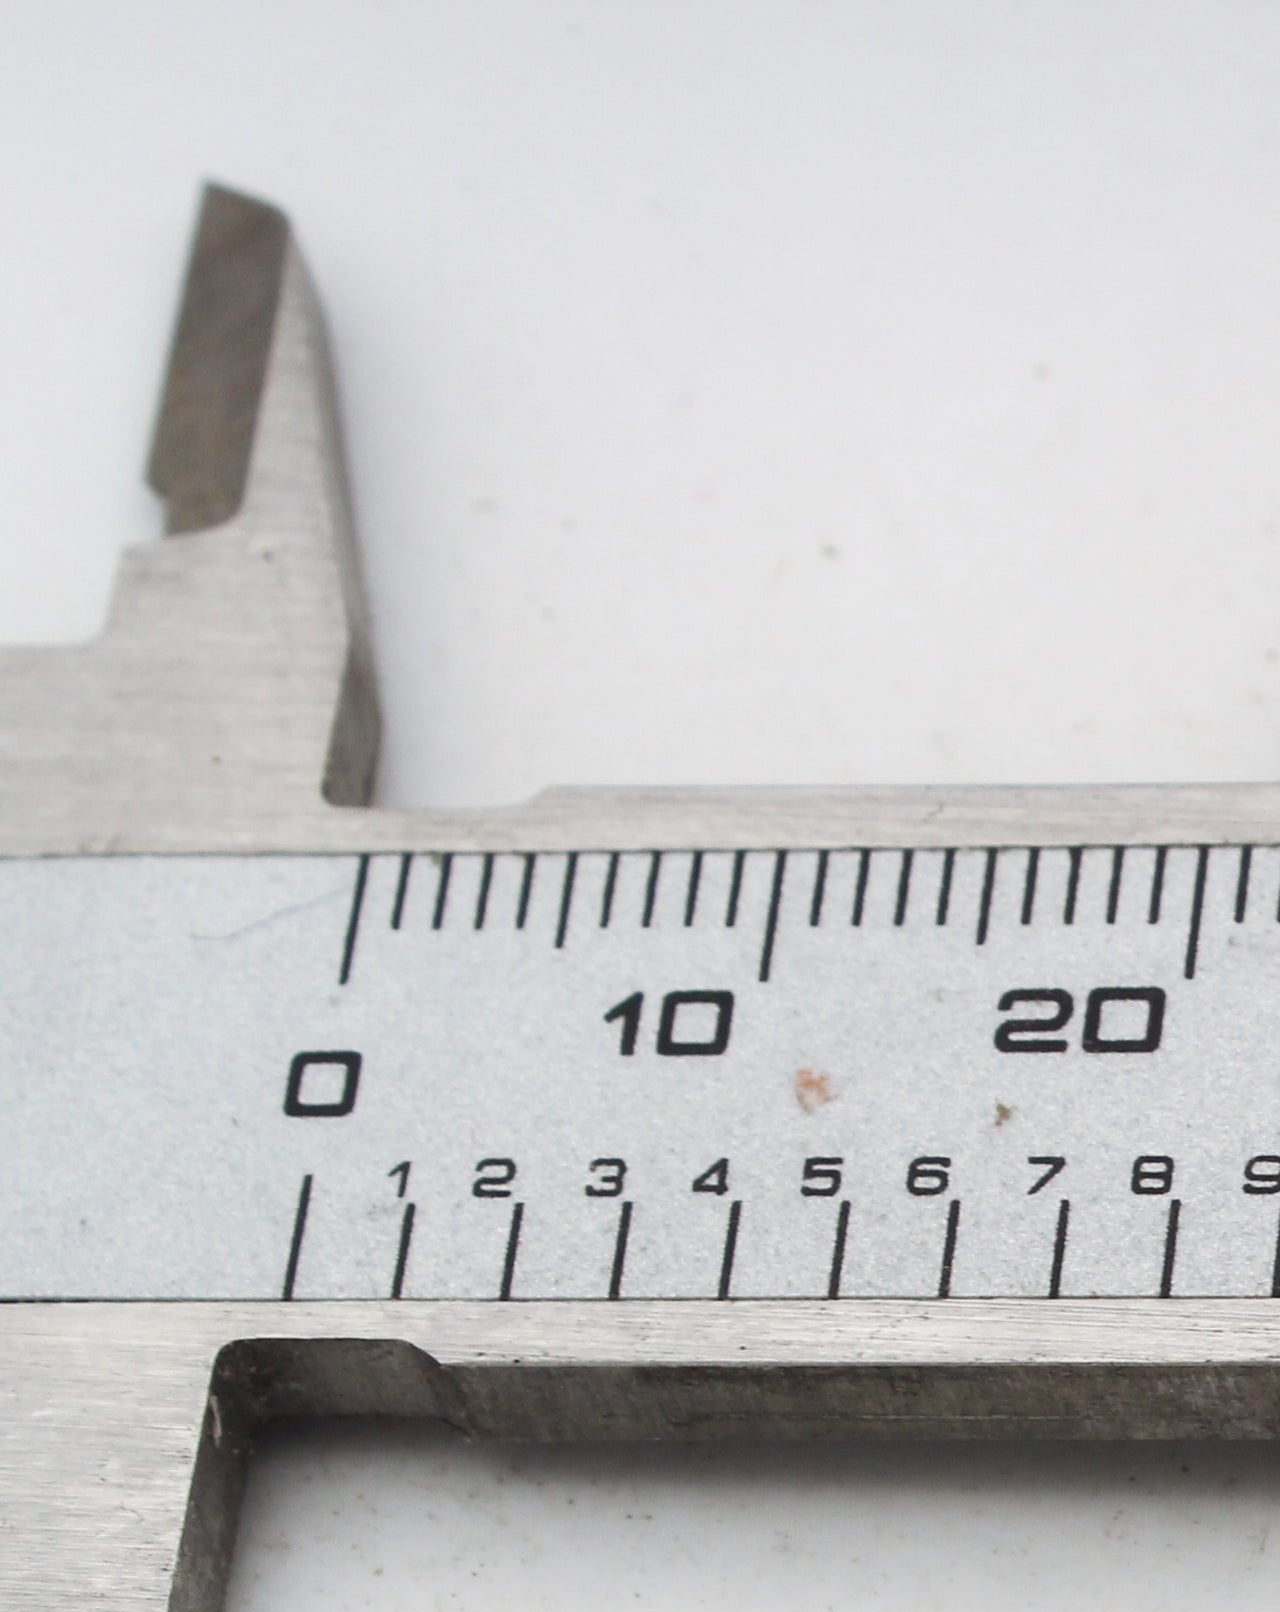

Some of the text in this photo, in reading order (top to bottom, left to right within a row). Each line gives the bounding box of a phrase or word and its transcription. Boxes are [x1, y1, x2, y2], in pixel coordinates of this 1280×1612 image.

[603, 990, 735, 1055] 10
[995, 987, 1166, 1052] 20
[284, 1051, 362, 1116] 0
[388, 1160, 412, 1198] 1
[471, 1157, 517, 1197] 2
[585, 1157, 628, 1197] 3
[691, 1157, 730, 1196] 4
[800, 1156, 844, 1196] 5
[905, 1156, 952, 1195] 6
[1026, 1156, 1069, 1195] 7
[1130, 1155, 1175, 1195] 8
